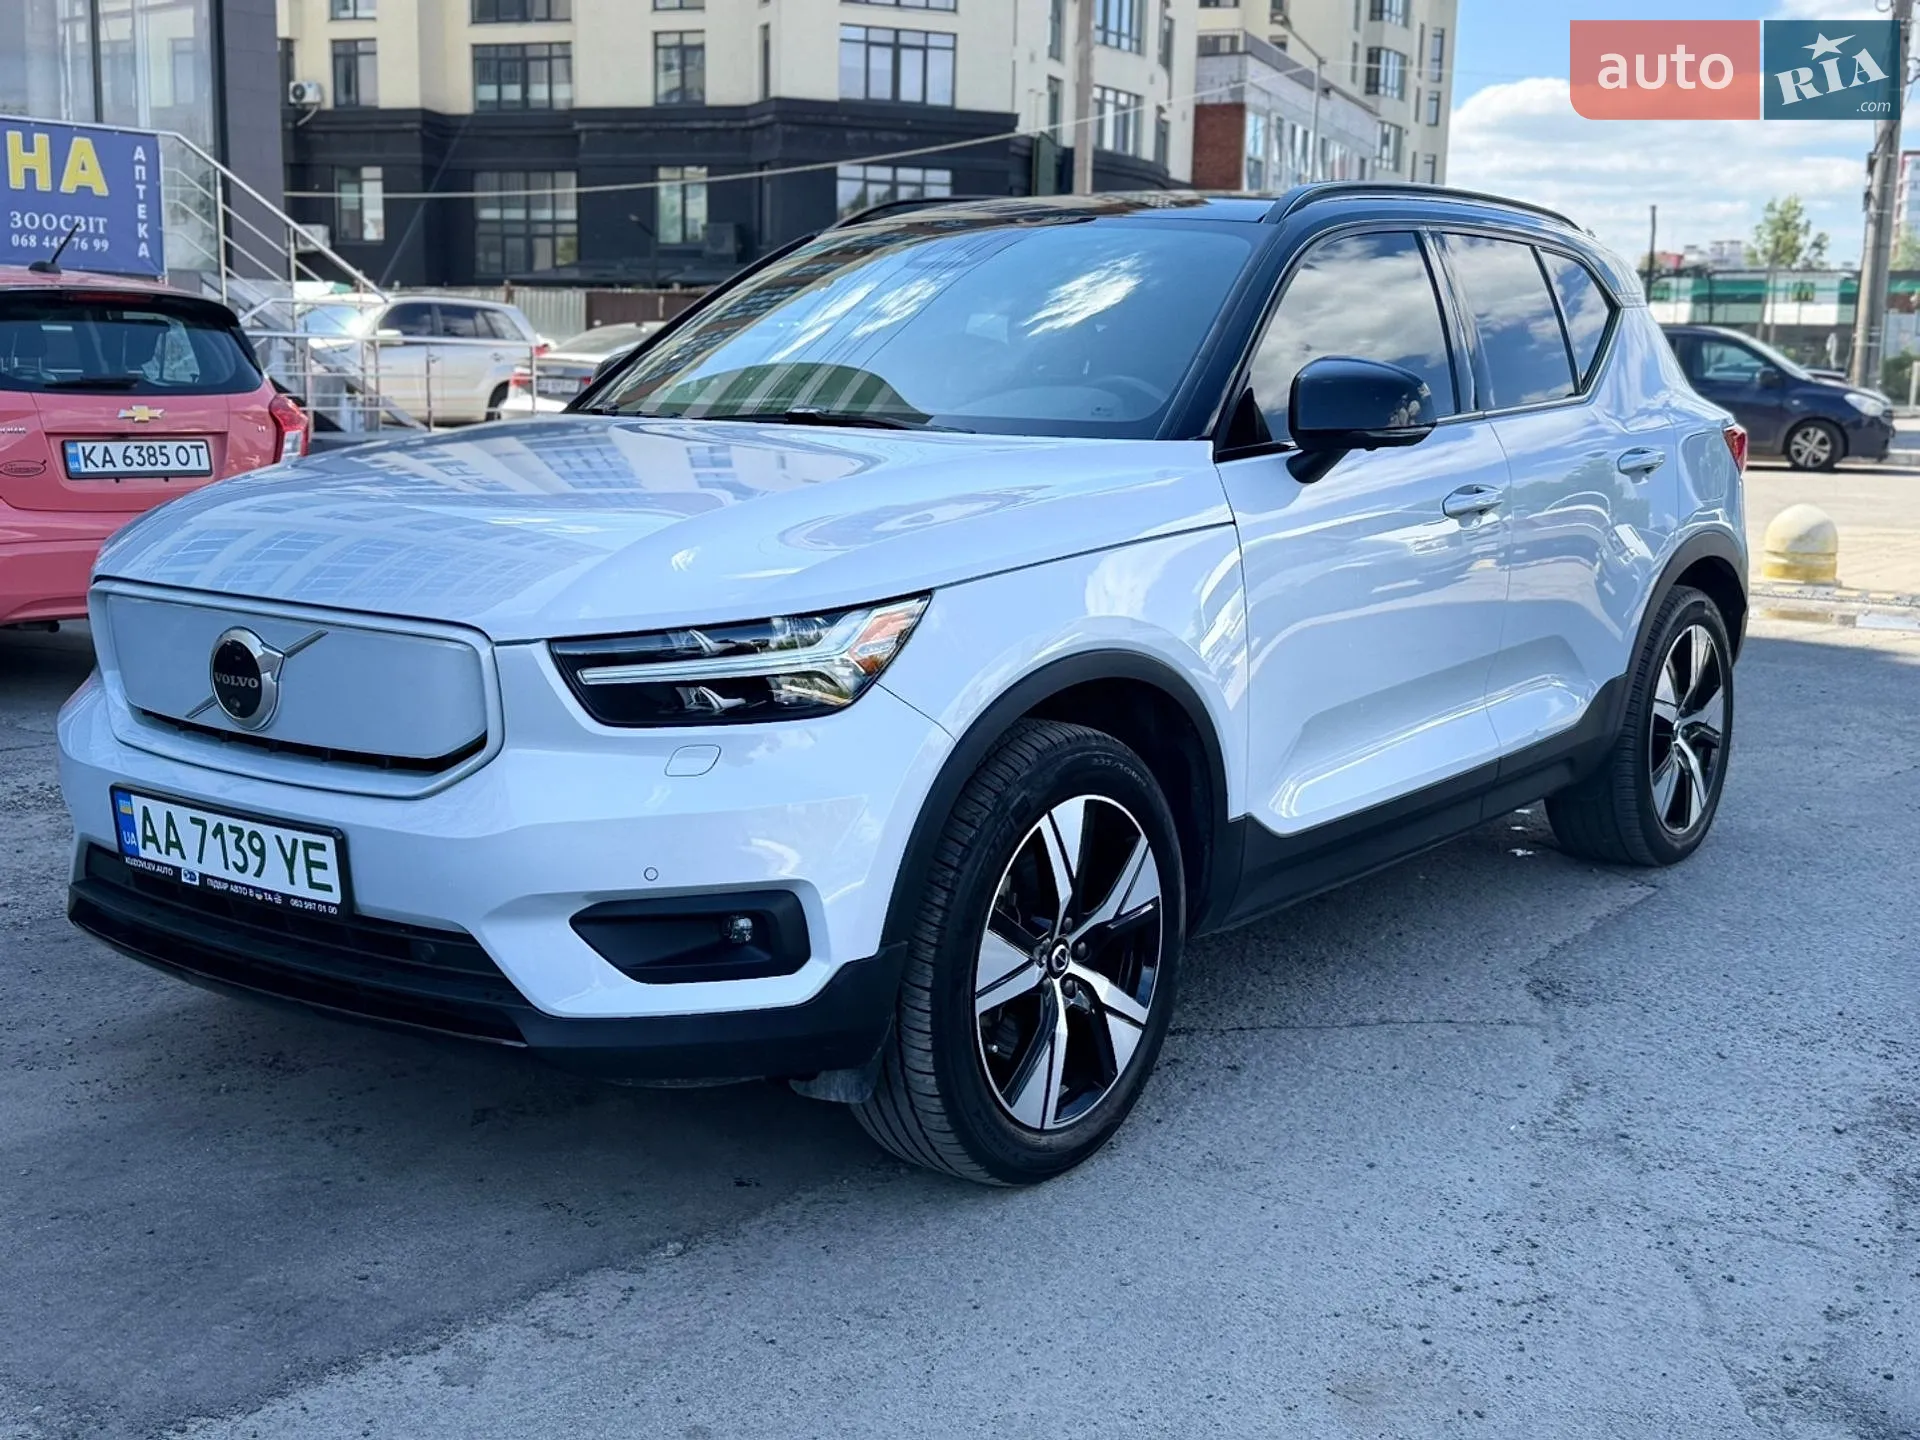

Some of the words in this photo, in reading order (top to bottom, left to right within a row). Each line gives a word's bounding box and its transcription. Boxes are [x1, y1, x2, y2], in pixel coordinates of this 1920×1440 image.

[133, 145, 150, 258] АПТЕКА
[10, 210, 108, 234] ЗООСВІТ
[11, 234, 37, 248] 068
[93, 238, 109, 252] 99
[81, 445, 117, 469] KA
[122, 445, 170, 467] 6385
[175, 445, 204, 467] OT
[214, 671, 259, 688] VOLVO
[122, 830, 137, 847] UA
[141, 805, 186, 860] AA
[189, 815, 267, 878] 7139
[274, 834, 333, 893] YE
